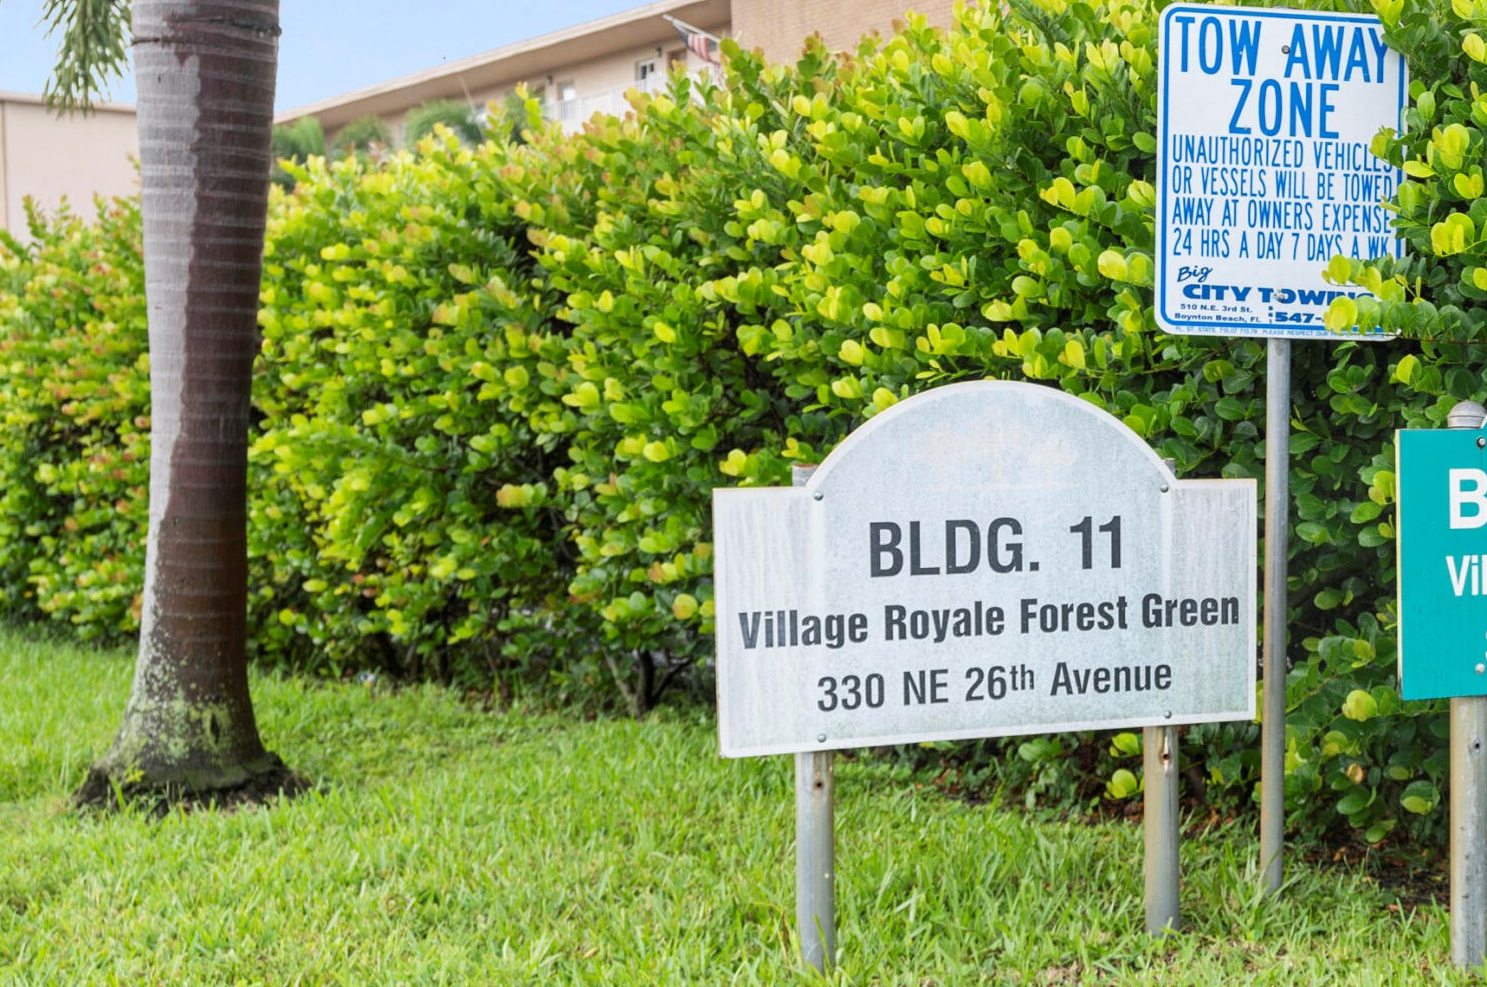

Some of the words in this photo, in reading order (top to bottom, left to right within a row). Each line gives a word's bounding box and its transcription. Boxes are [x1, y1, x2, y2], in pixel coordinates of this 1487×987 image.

[1175, 16, 1262, 76] TOW
[1284, 23, 1388, 83] AWAY
[1228, 78, 1340, 139] ZONE
[1172, 134, 1304, 168] UNAUTHORIZED
[1172, 165, 1192, 194] OR
[1201, 167, 1267, 198] VESSELS
[1275, 170, 1309, 199] WILL
[1317, 172, 1335, 201] BE
[1343, 173, 1393, 203] TOWED
[1172, 196, 1214, 226] AWAY
[1221, 198, 1240, 227] AT
[1247, 199, 1313, 230] OWNERS
[1322, 203, 1392, 234] EXPENSE
[1173, 227, 1192, 256] 24
[1200, 228, 1230, 258] HRS
[1239, 230, 1249, 259] A
[1257, 231, 1284, 260] DAY
[1291, 232, 1300, 261] 7
[1307, 233, 1343, 262] DAYS
[1351, 235, 1360, 258] A
[1177, 265, 1213, 283] Big
[1183, 283, 1252, 302] CITY
[1174, 312, 1213, 322] Boynton
[1215, 314, 1248, 323] Beach,
[1180, 303, 1197, 311] 510
[1240, 305, 1253, 313] St.
[869, 516, 1040, 578] BLDG.
[1069, 515, 1122, 570] 11
[739, 609, 868, 650] Village
[884, 601, 1005, 642] Royale
[1020, 595, 1128, 634] Forest
[1142, 592, 1240, 629] Green
[817, 672, 885, 712] 330
[902, 669, 949, 705] NE
[965, 663, 1035, 702] 26th
[1050, 660, 1173, 697] Avenue
